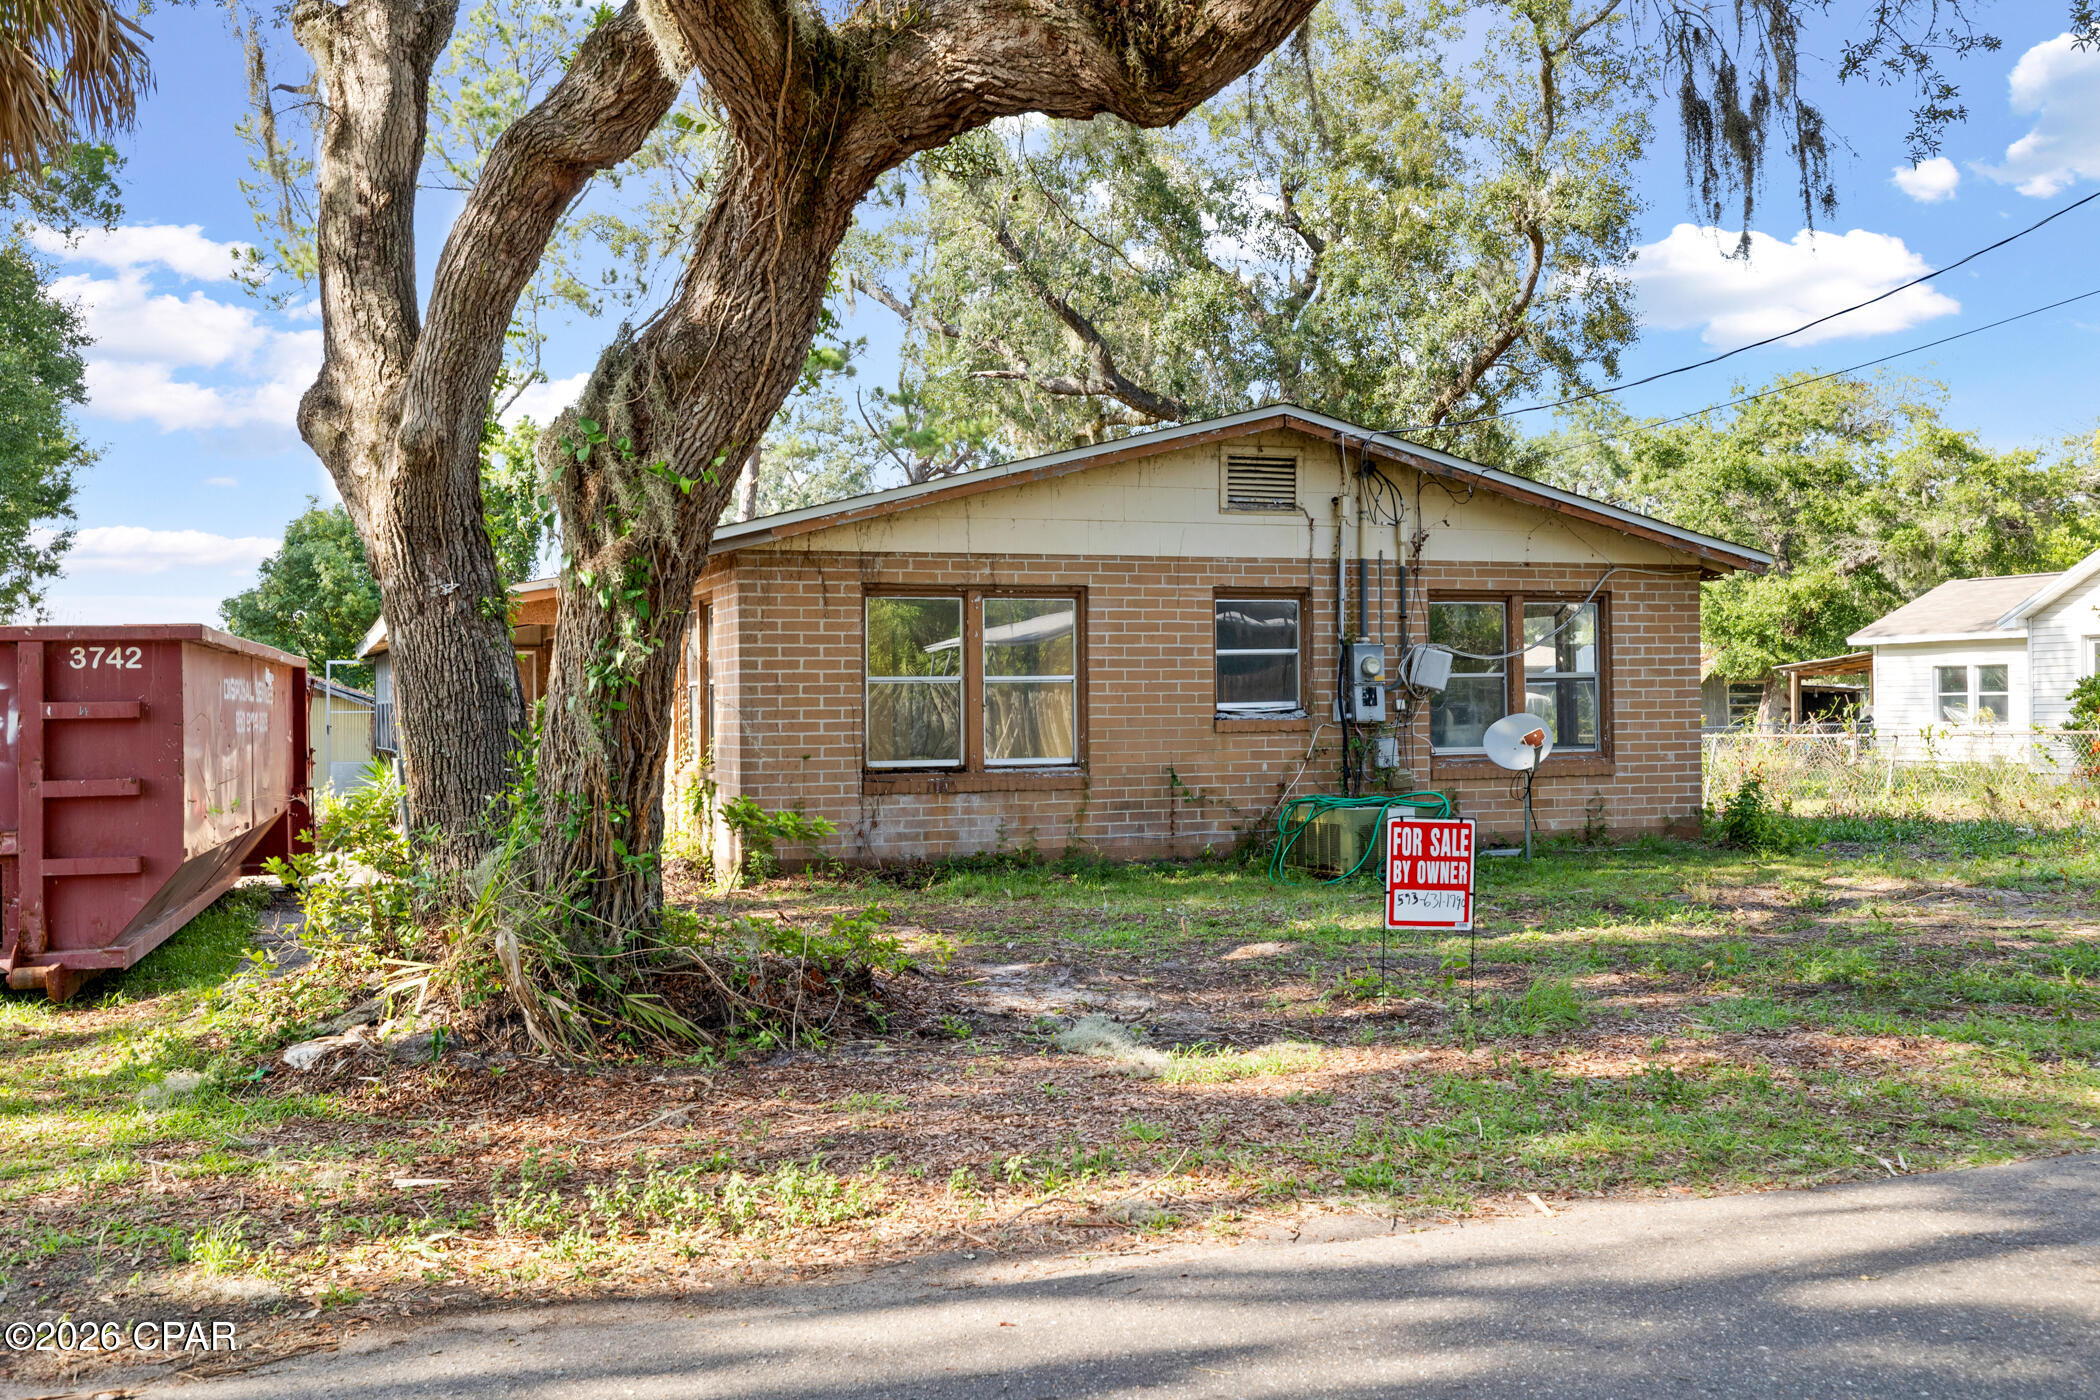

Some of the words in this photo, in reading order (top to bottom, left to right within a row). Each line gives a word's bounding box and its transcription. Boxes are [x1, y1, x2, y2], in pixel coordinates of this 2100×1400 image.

[69, 646, 142, 669] 3742
[1393, 827, 1422, 856] FOR
[1430, 827, 1469, 857] SALE
[1393, 860, 1411, 883] BY
[1417, 860, 1468, 884] OWNER
